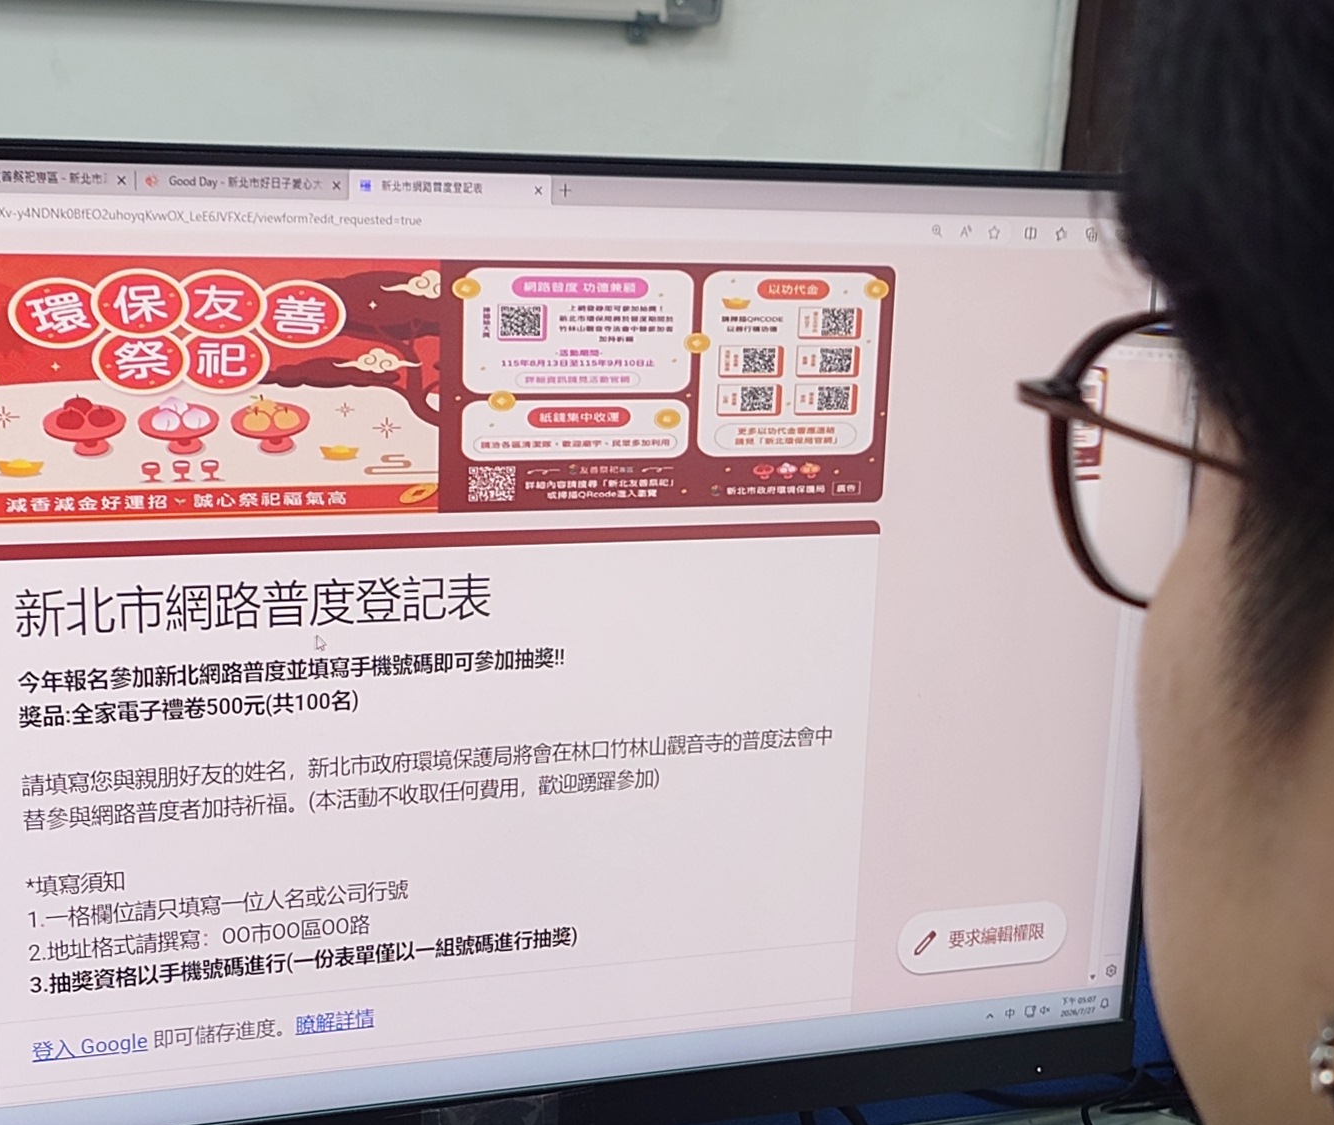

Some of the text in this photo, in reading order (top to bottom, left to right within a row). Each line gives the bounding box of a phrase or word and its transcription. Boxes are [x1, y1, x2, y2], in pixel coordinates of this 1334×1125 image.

[169, 175, 191, 188] Good
[194, 176, 218, 190] Day
[769, 284, 818, 294] 以功代金
[26, 284, 326, 335] 環保友善
[114, 341, 247, 380] 祭祀
[6, 491, 347, 514] 減香減金好運招 誠心祭祀福氣高
[15, 573, 492, 638] 新北市網路普度登記表
[948, 921, 1045, 949] 要求編輯權限
[32, 1039, 74, 1062] 登入
[81, 1031, 148, 1058] Google
